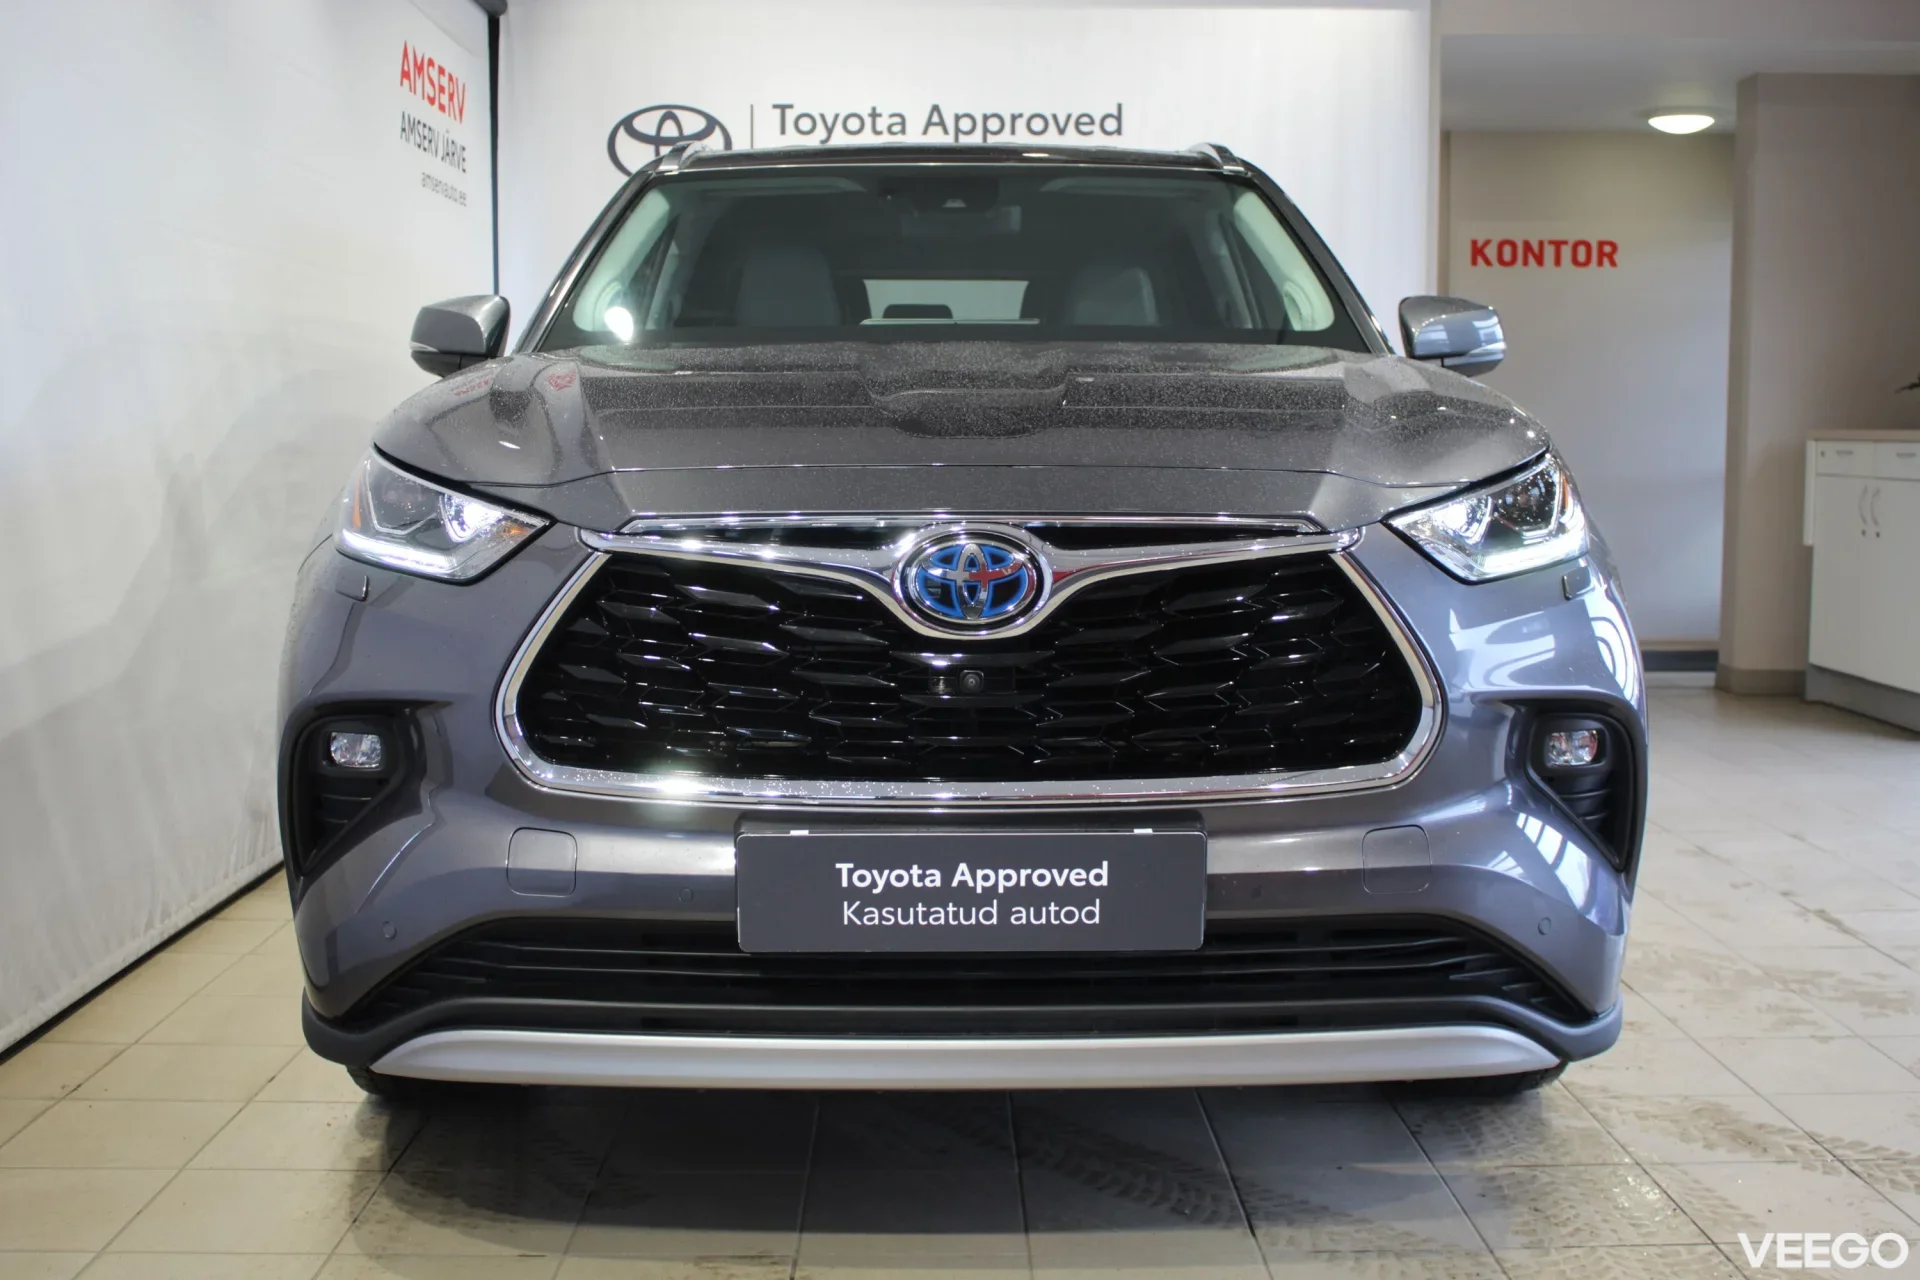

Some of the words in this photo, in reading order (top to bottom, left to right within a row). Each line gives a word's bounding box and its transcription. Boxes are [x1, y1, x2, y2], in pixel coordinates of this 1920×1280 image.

[400, 39, 466, 125] AMSERV
[772, 103, 907, 144] Toyota
[921, 102, 1123, 143] Approved
[400, 110, 440, 159] AMSERV
[440, 127, 467, 174] JÄRVE
[1470, 239, 1619, 268] KONTOR
[835, 863, 942, 894] Toyota
[951, 861, 1109, 893] Approved
[843, 898, 998, 926] Kasutatud
[1010, 898, 1101, 925] autod
